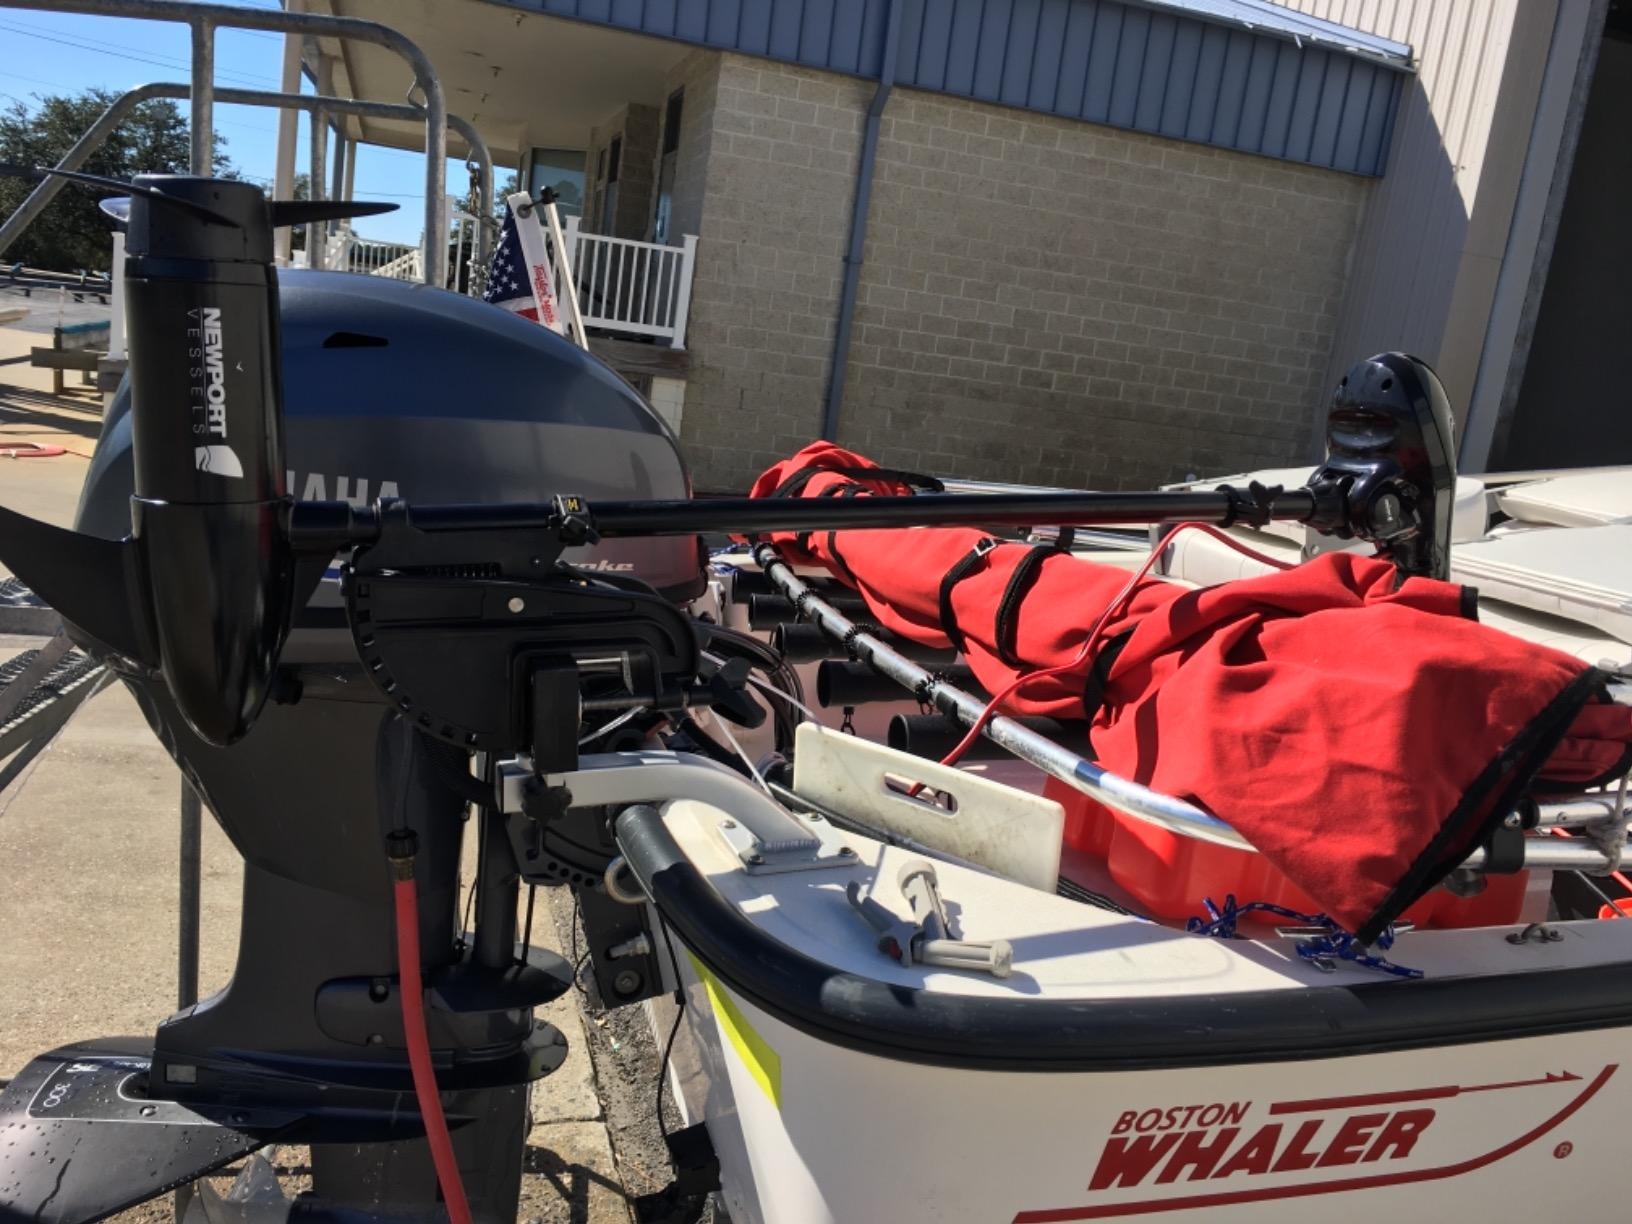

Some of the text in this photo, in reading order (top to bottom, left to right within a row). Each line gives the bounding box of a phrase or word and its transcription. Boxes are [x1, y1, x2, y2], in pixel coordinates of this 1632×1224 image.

[187, 308, 206, 434] VESSELS
[203, 307, 227, 439] NEWPORT
[1087, 1108, 1437, 1191] WHALER
[1111, 1101, 1252, 1136] BOSTON
